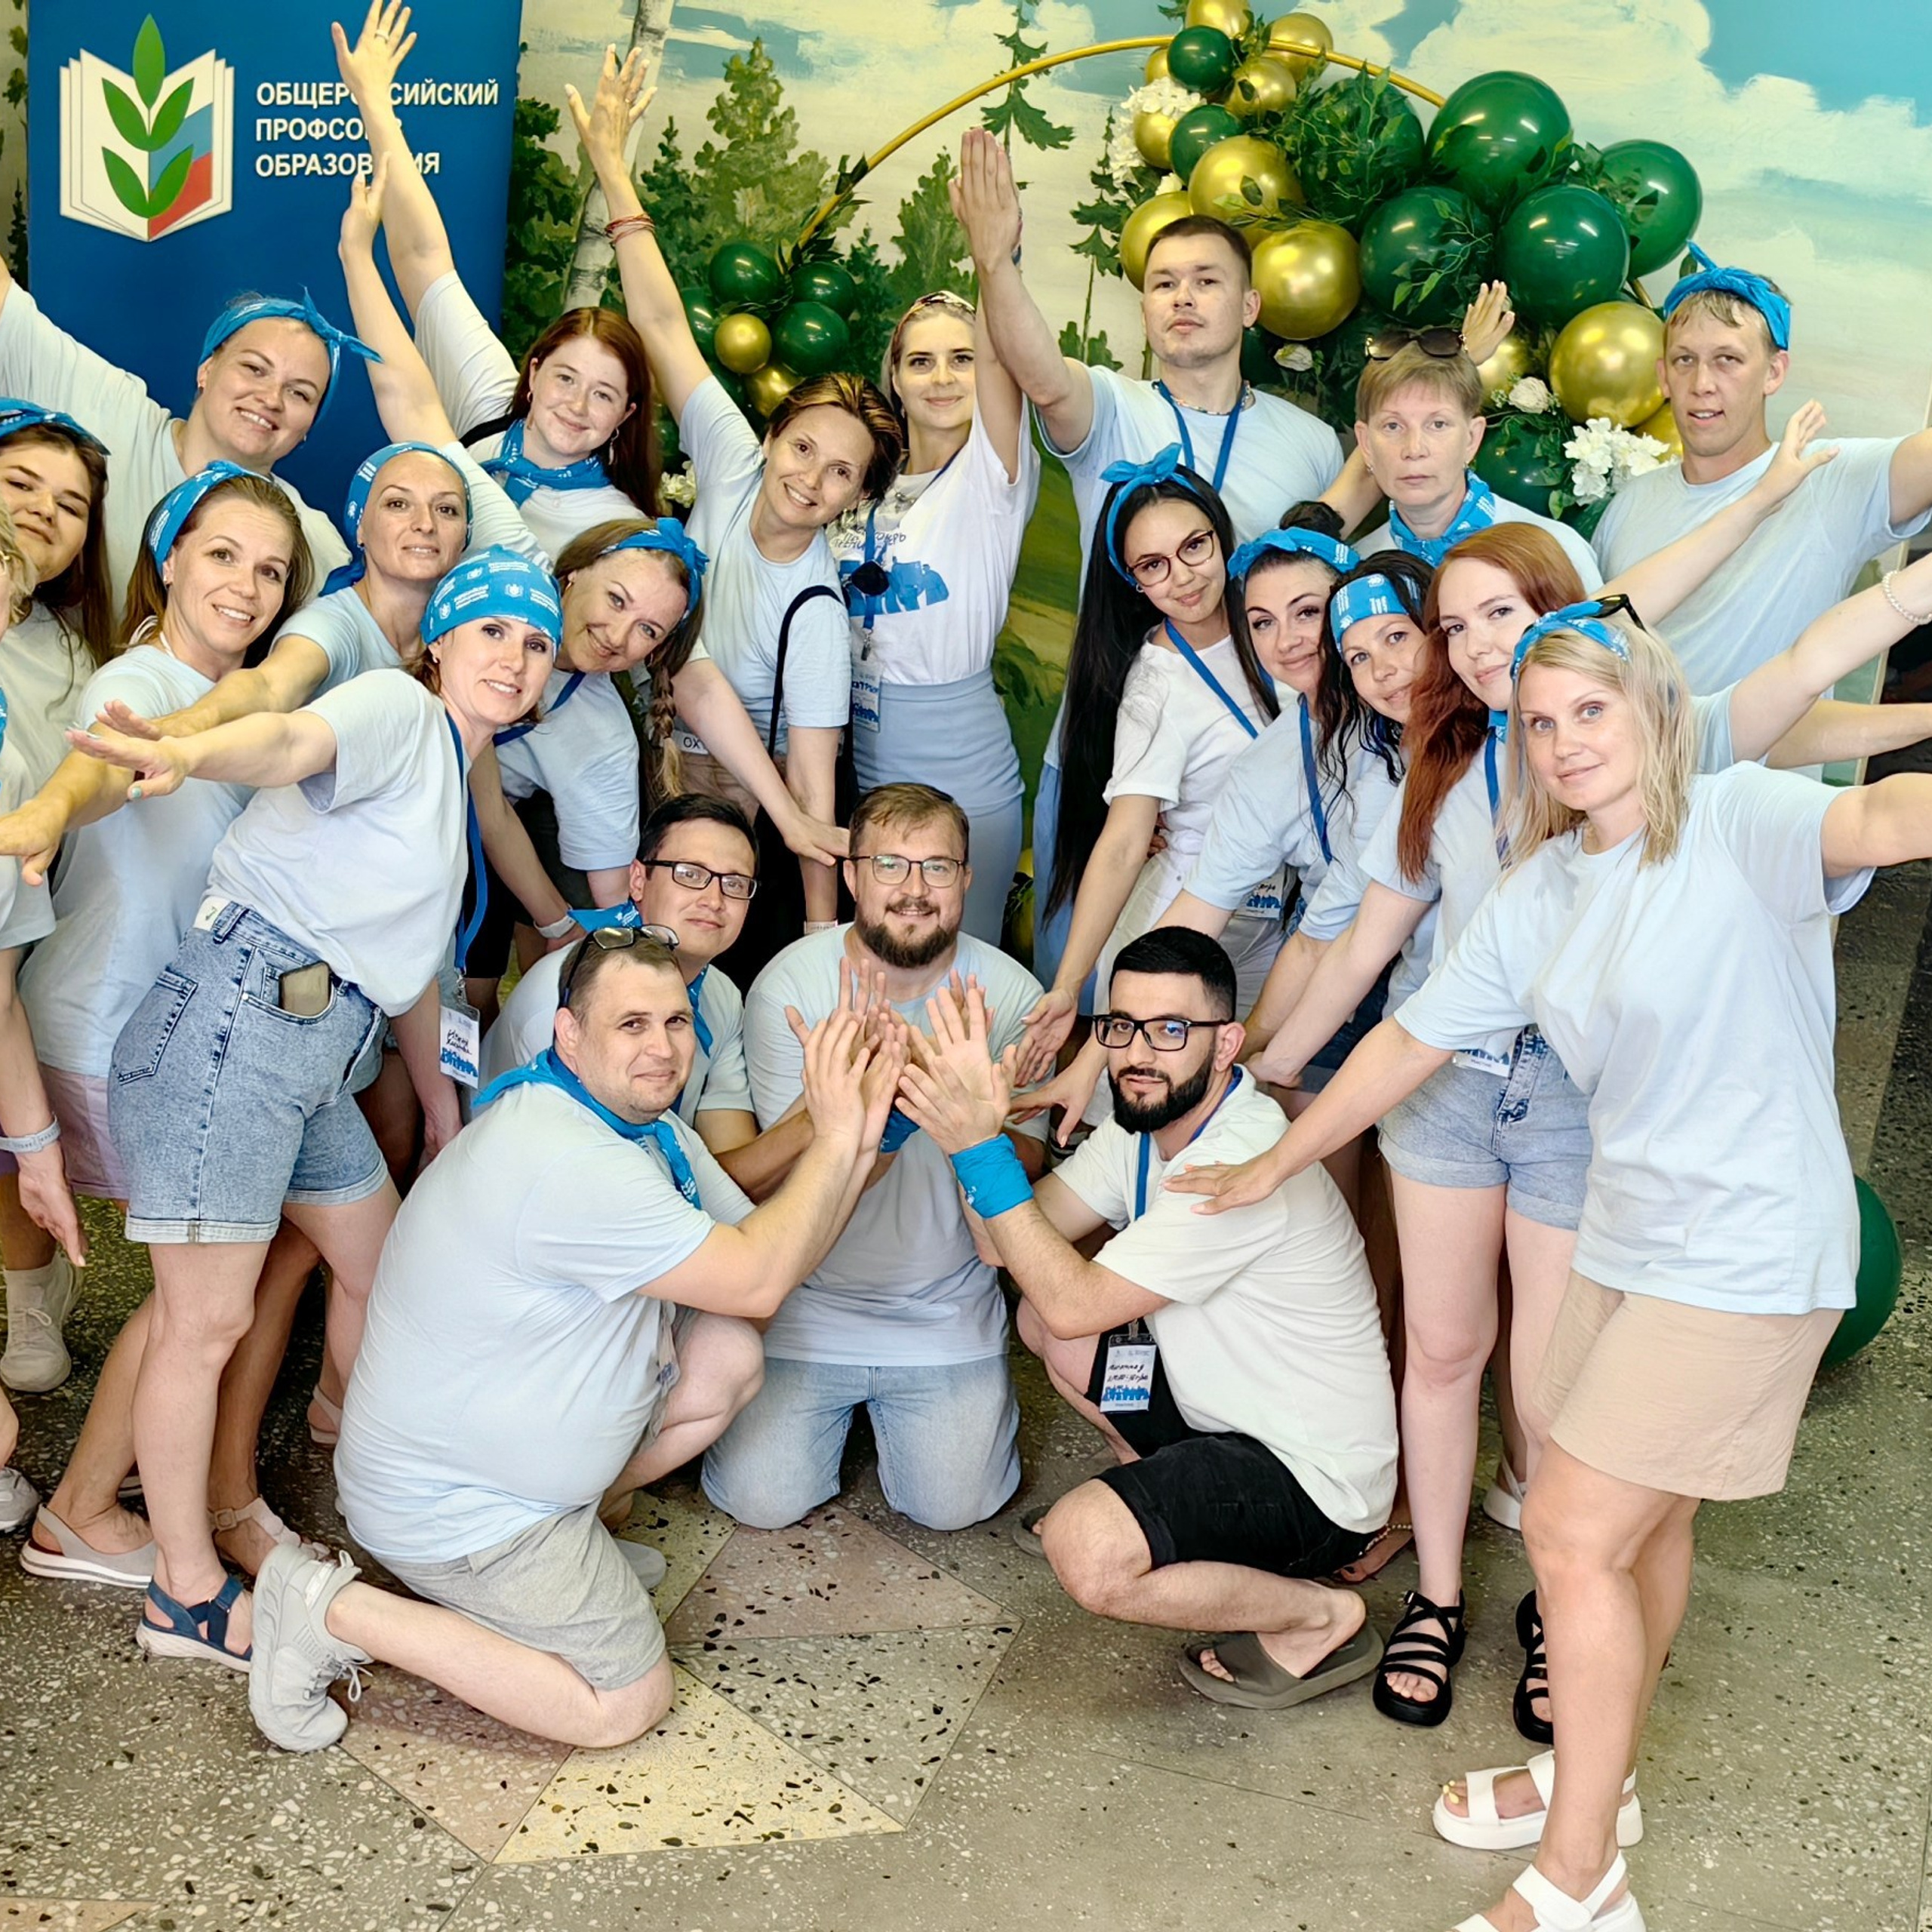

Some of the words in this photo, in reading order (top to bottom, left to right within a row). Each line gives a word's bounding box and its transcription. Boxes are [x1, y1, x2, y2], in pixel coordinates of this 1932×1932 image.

[256, 78, 499, 109] ОБЩЕРСИЙСКИЙ
[255, 117, 402, 142] ПРОФСО
[255, 152, 440, 177] ОБРАЗОВИЯ
